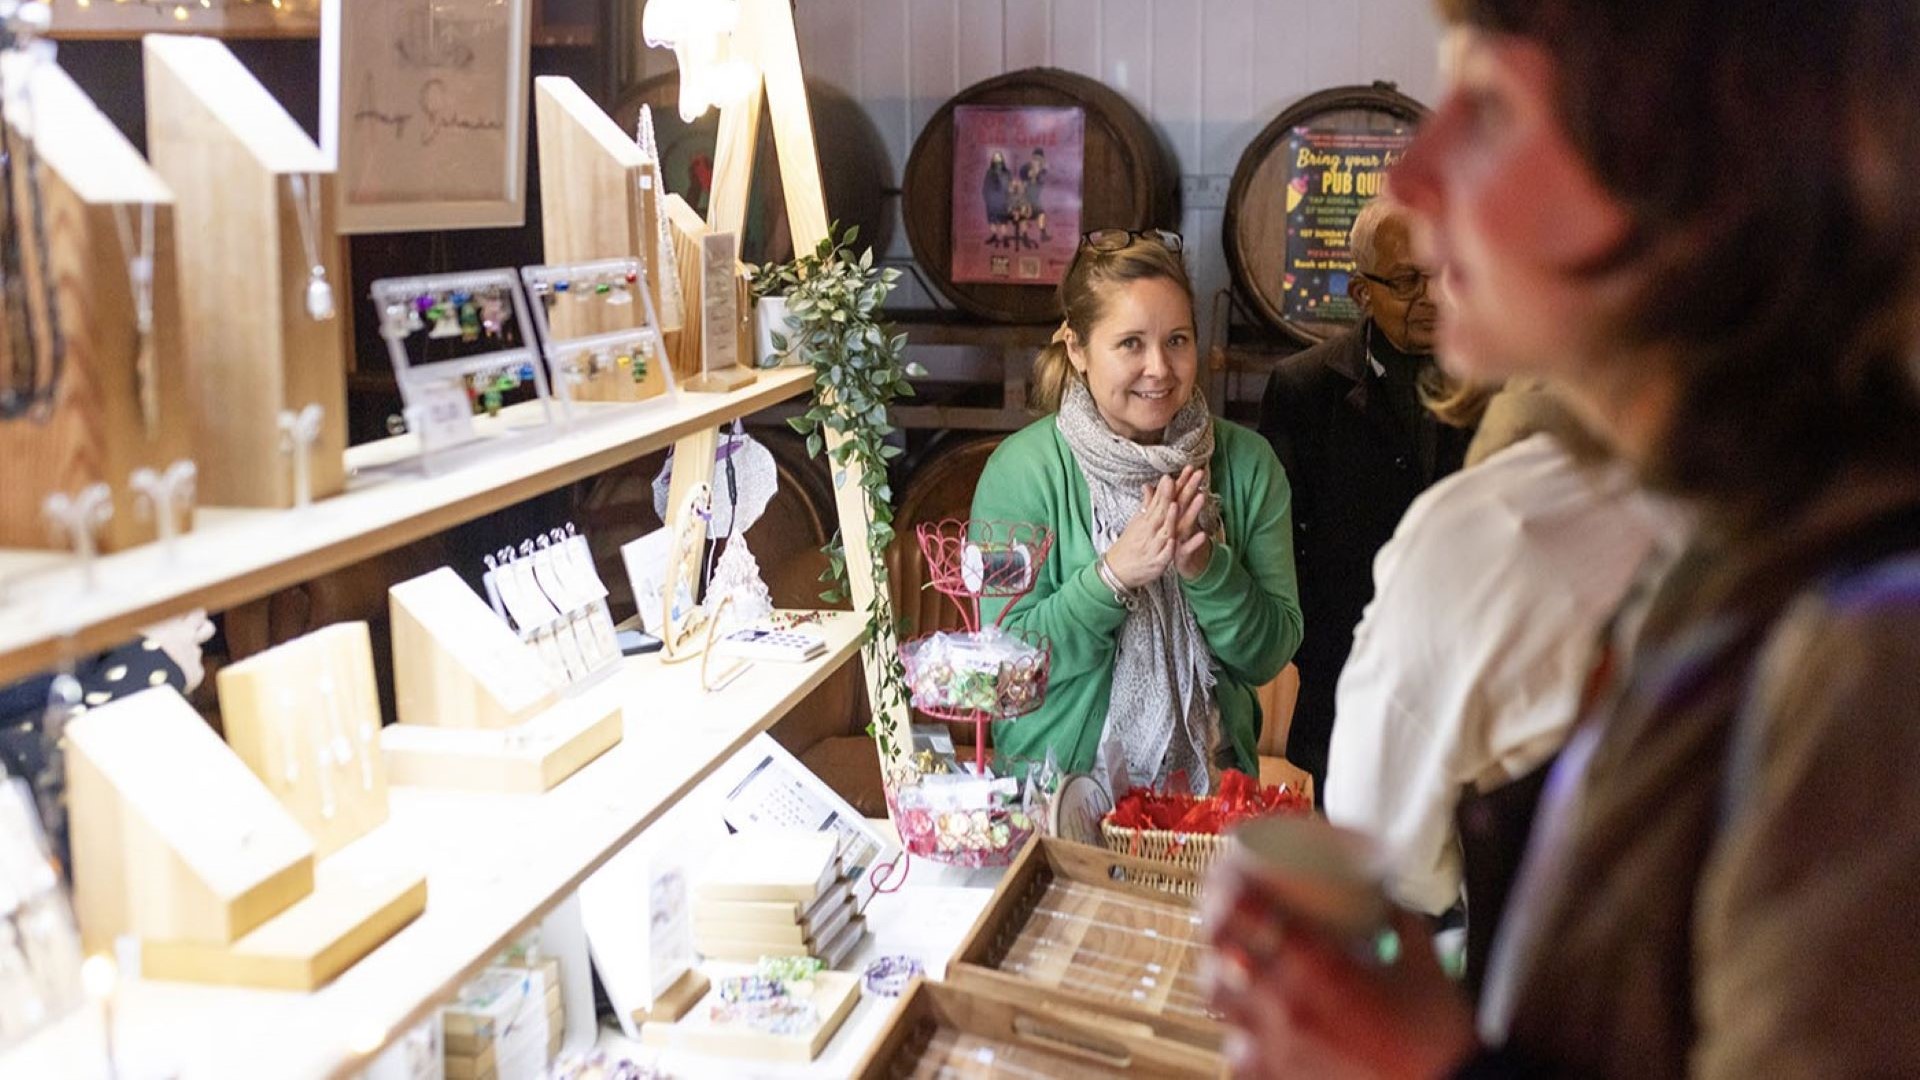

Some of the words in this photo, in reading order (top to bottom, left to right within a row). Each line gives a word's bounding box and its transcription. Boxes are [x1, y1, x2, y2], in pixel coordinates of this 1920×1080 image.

[1296, 146, 1341, 173] Bring
[1345, 154, 1381, 172] your
[1322, 172, 1352, 194] PUB
[1315, 229, 1347, 238] SUNDAY
